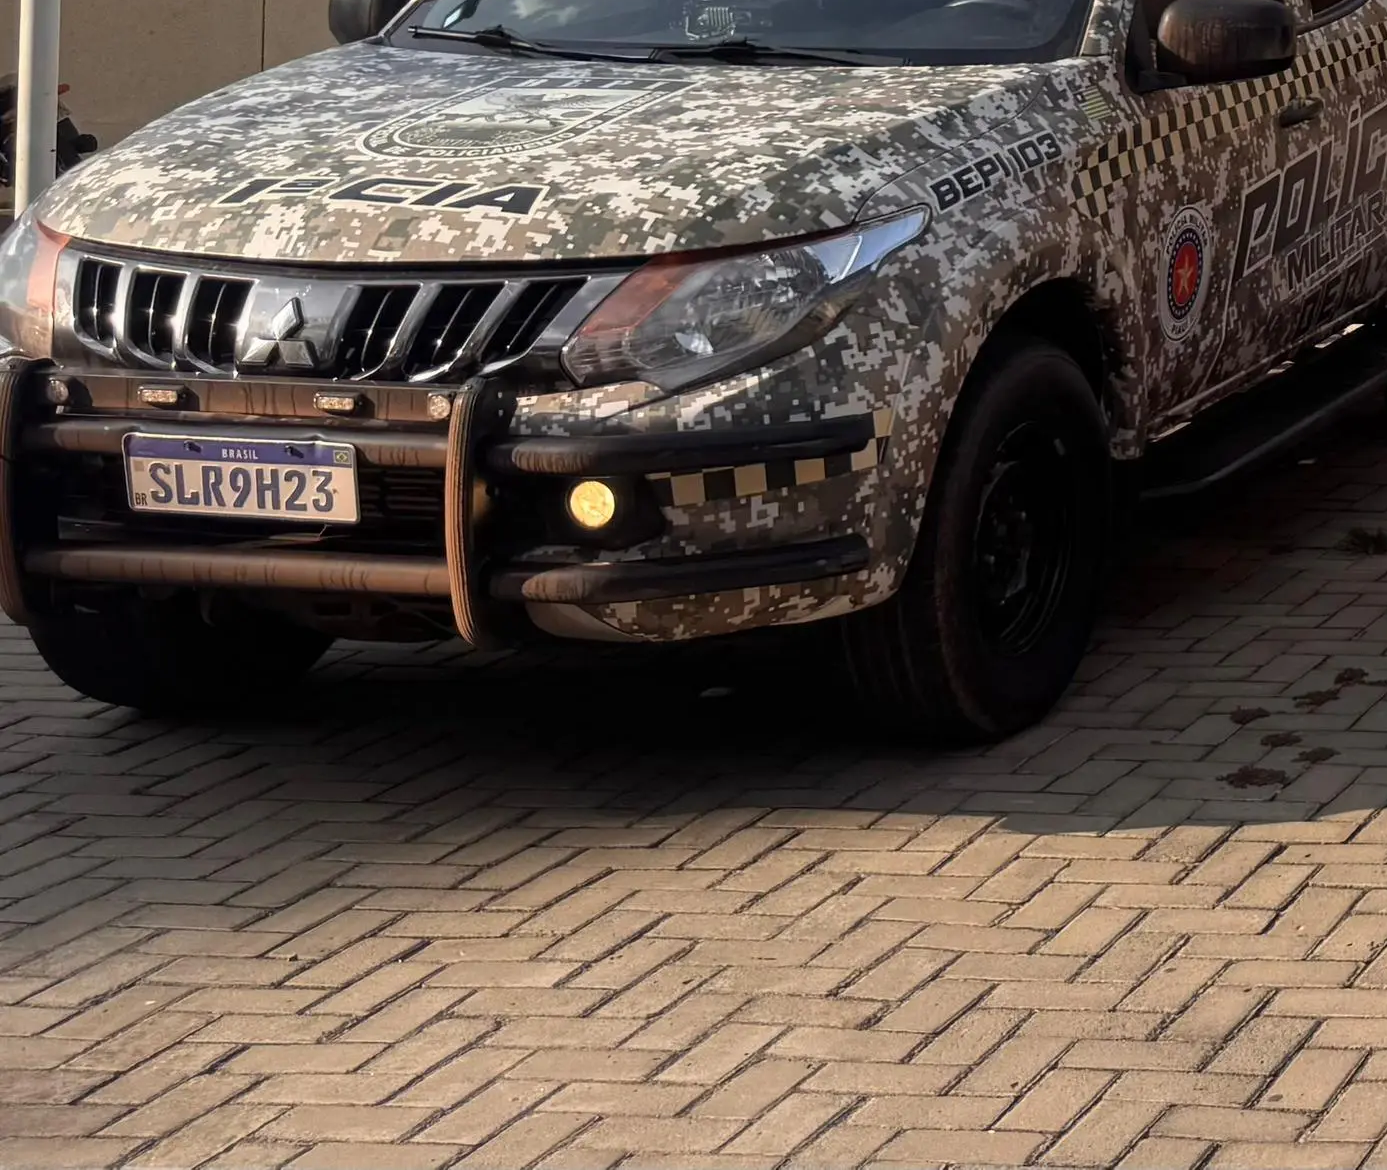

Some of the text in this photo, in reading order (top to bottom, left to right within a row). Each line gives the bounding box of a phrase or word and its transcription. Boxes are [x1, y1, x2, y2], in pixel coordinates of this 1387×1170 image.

[928, 132, 1063, 212] BEPI 103
[326, 175, 549, 217] CIA
[221, 448, 258, 460] BRASIL
[134, 492, 148, 506] BR
[149, 461, 334, 513] SLR9H23
